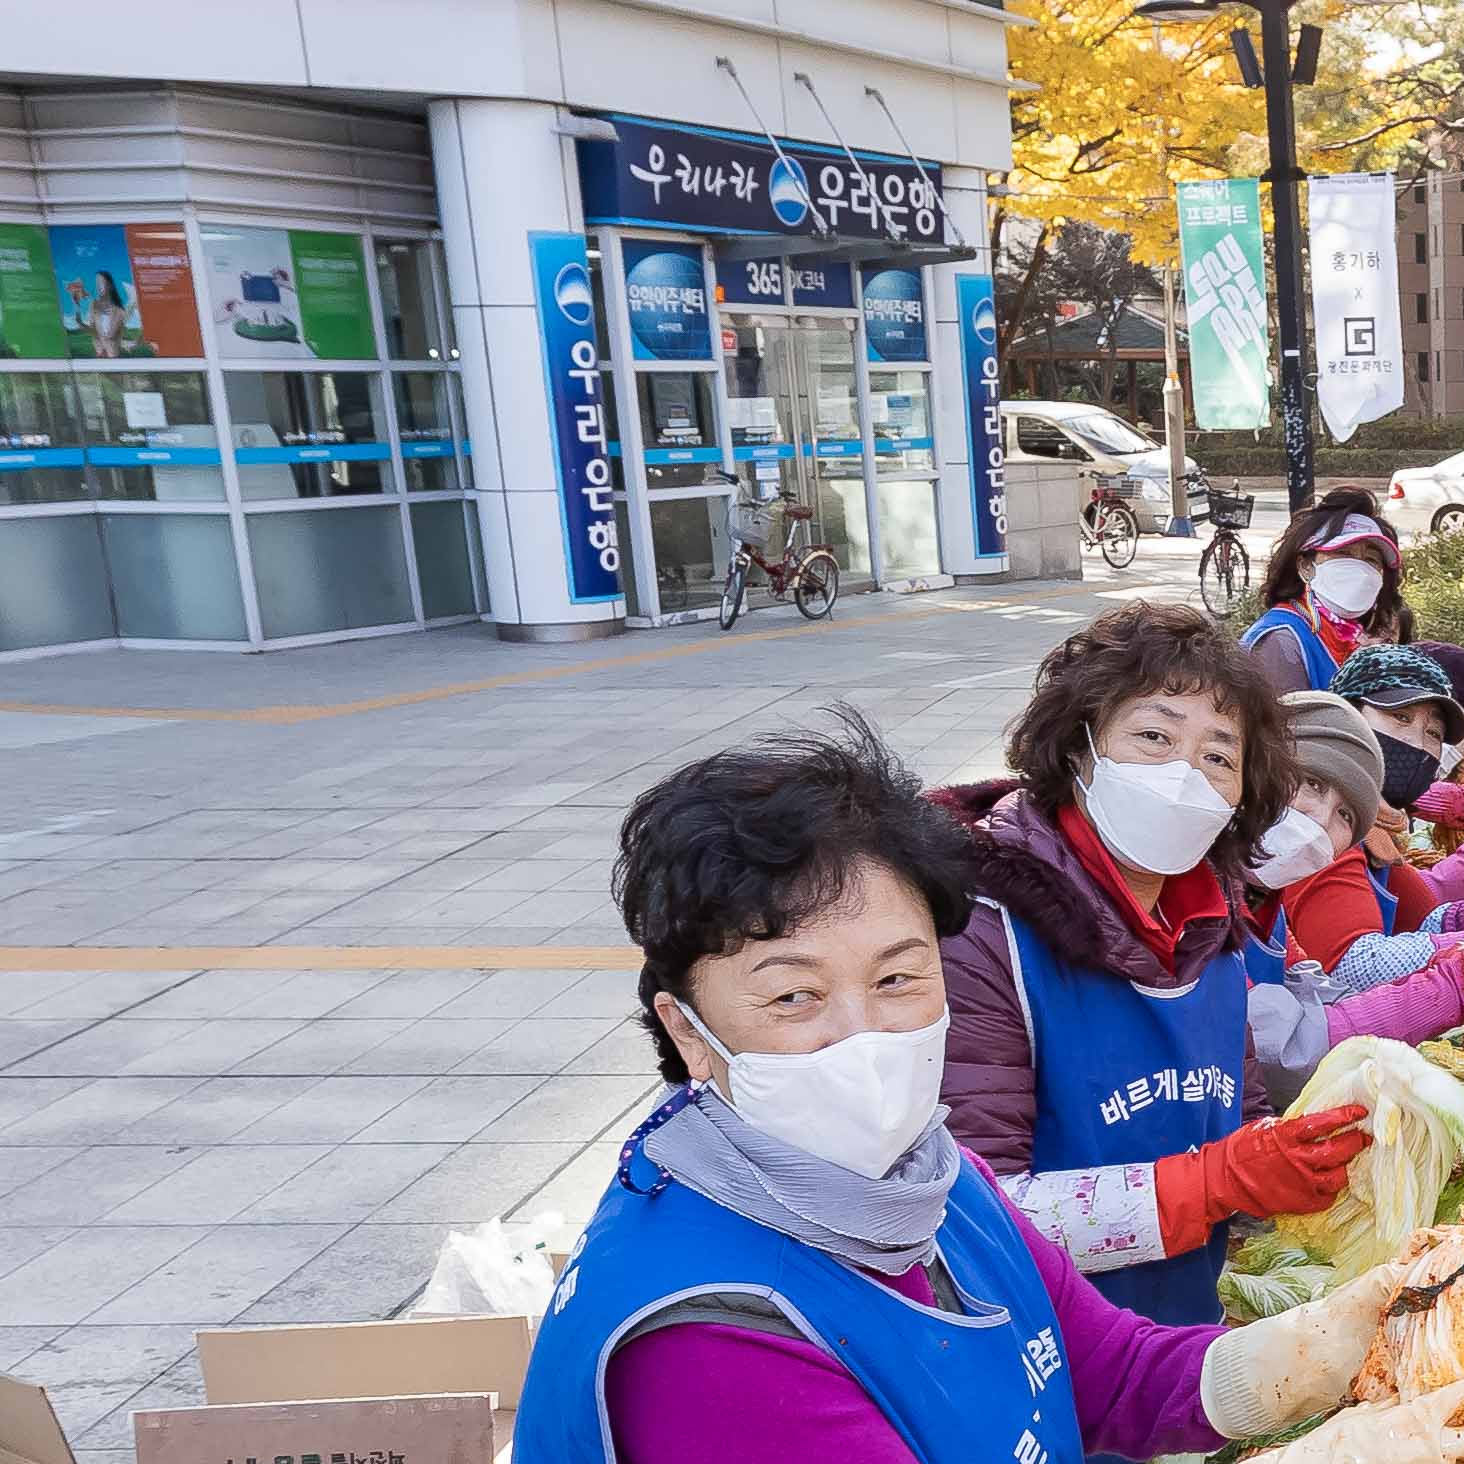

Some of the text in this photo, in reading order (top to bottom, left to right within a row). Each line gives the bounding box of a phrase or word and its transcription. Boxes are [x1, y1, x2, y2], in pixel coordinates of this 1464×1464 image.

[630, 144, 760, 205] 우리나라
[818, 165, 937, 235] 우리은행
[1186, 204, 1249, 227] 프로젝트
[746, 261, 782, 295] 365
[568, 340, 620, 571] 우리은행
[980, 357, 1008, 535] 우리은행
